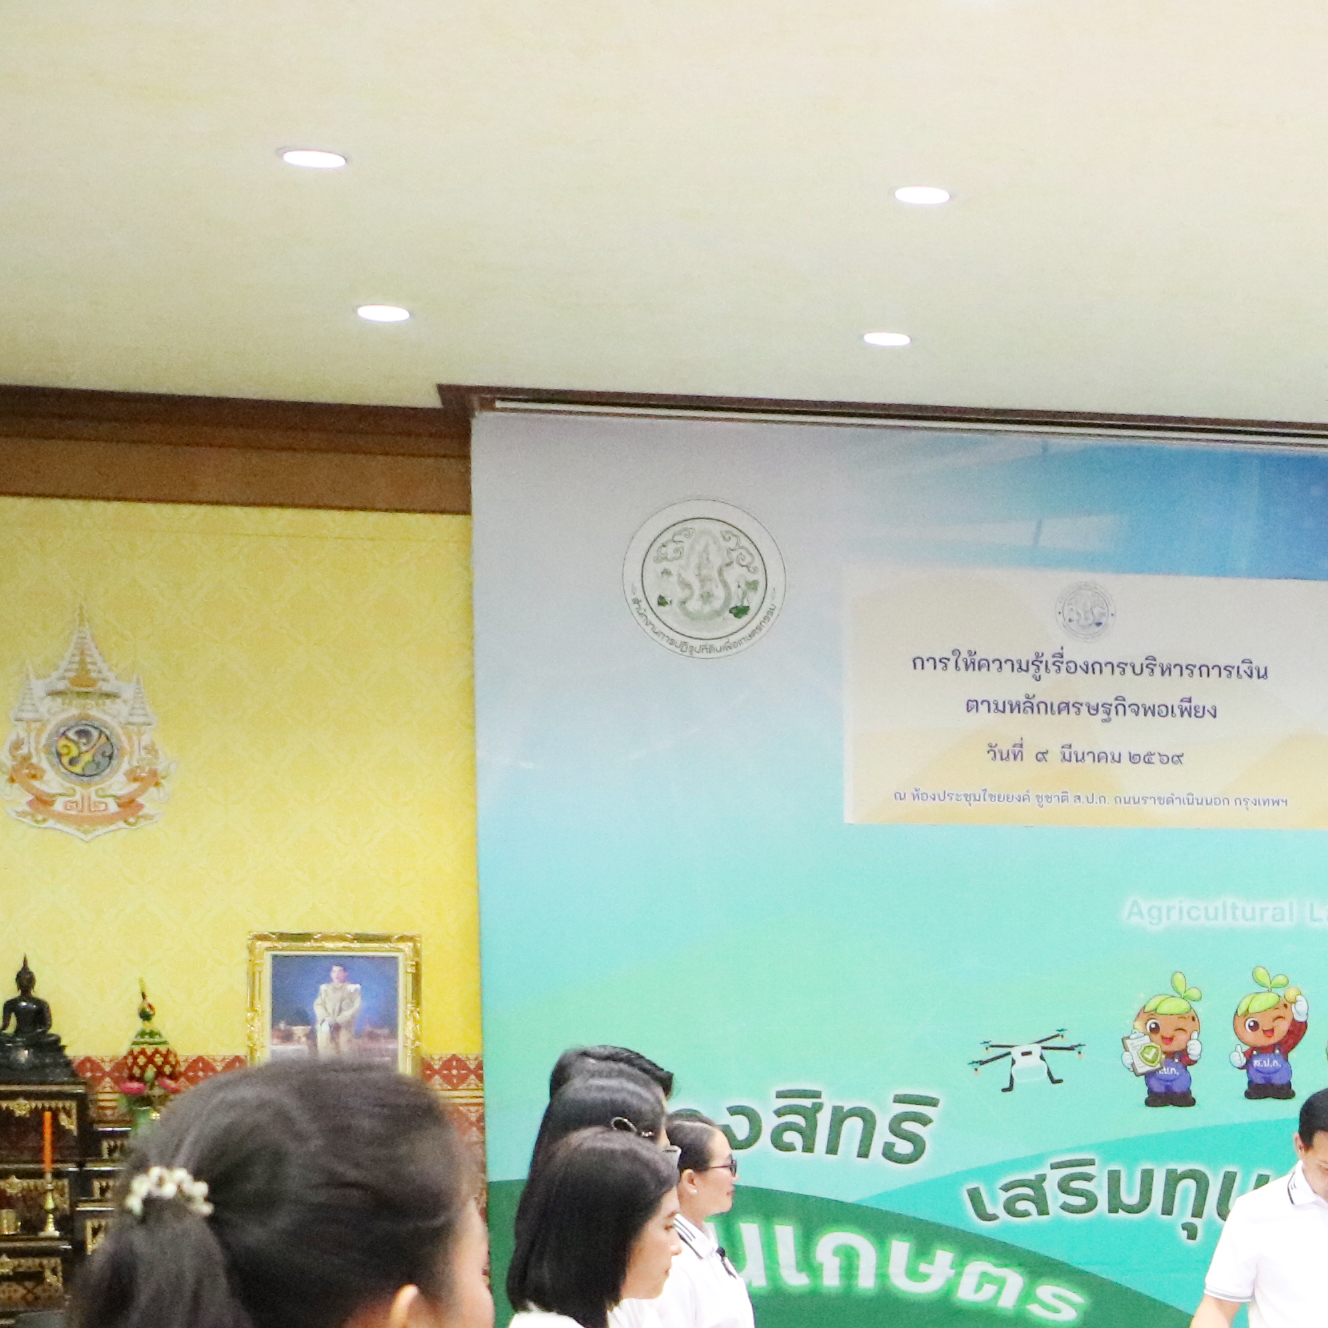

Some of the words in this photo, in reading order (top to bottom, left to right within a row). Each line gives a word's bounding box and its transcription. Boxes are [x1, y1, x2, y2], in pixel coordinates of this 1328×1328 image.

[912, 646, 1269, 682] การให้ความรู้เรื่องการบริหารการเงิน
[966, 693, 1217, 723] ตามหลักเศรษฐกิจพอเพียง
[987, 738, 1023, 762] วันที่
[1035, 750, 1049, 763] ๙
[1060, 743, 1122, 764] มีนาคม
[1128, 751, 1185, 765] ๒๕๖๙
[893, 791, 907, 802] ณ
[1073, 793, 1110, 805] ส.ป.ก.
[1114, 793, 1230, 807] ถนนราชดำเนินนอก
[1234, 797, 1288, 811] กรุงเทพฯ
[1126, 899, 1294, 926] Agricultural
